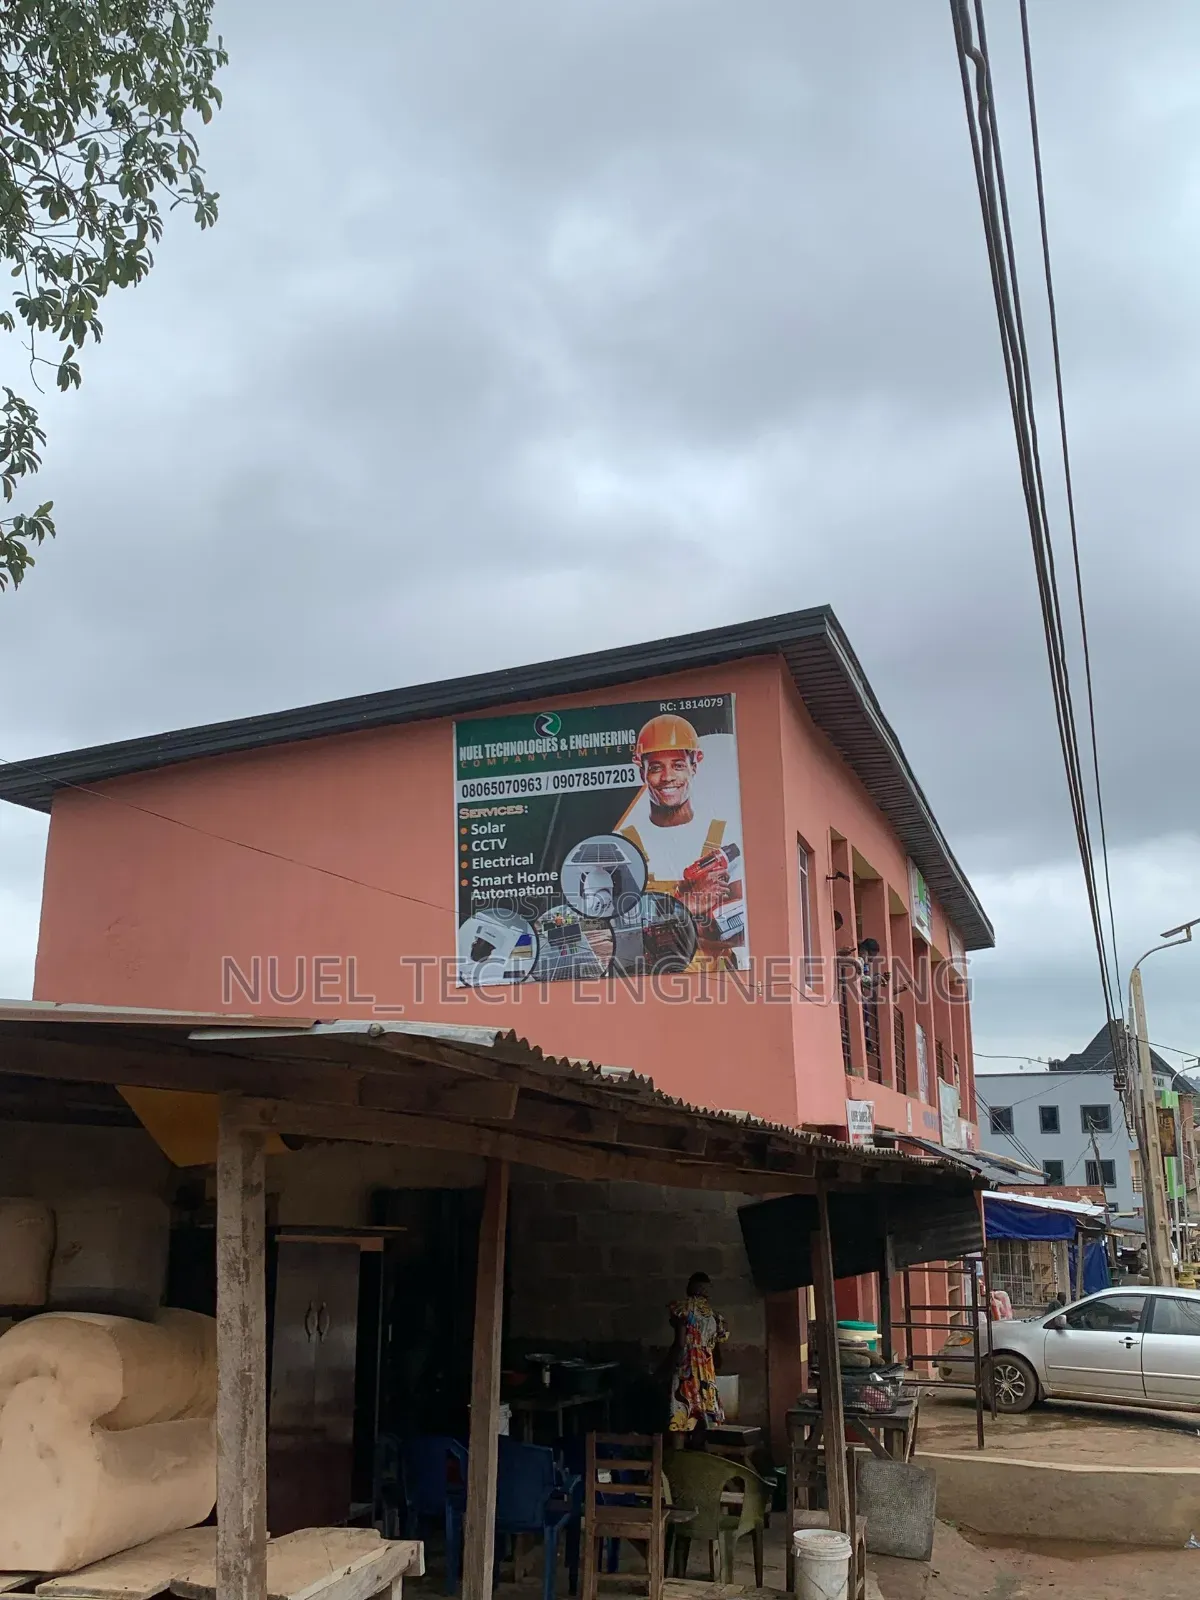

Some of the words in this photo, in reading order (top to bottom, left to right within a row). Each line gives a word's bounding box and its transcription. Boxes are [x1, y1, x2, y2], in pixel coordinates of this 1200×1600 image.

[660, 702, 677, 712] RC:
[679, 697, 723, 710] 1814079
[459, 745, 484, 761] NUEL
[485, 737, 558, 758] TECHNOLOGIES
[560, 738, 568, 750] &
[569, 729, 636, 750] ENGINEERING
[461, 777, 542, 798] 08065070963
[545, 775, 550, 791] /
[552, 768, 636, 789] 09078507203
[471, 822, 506, 835] Solar
[471, 838, 507, 852] CCTV
[472, 853, 534, 869] Electrical
[472, 874, 513, 887] Smart
[517, 871, 559, 883] Home
[471, 884, 554, 900] Automation
